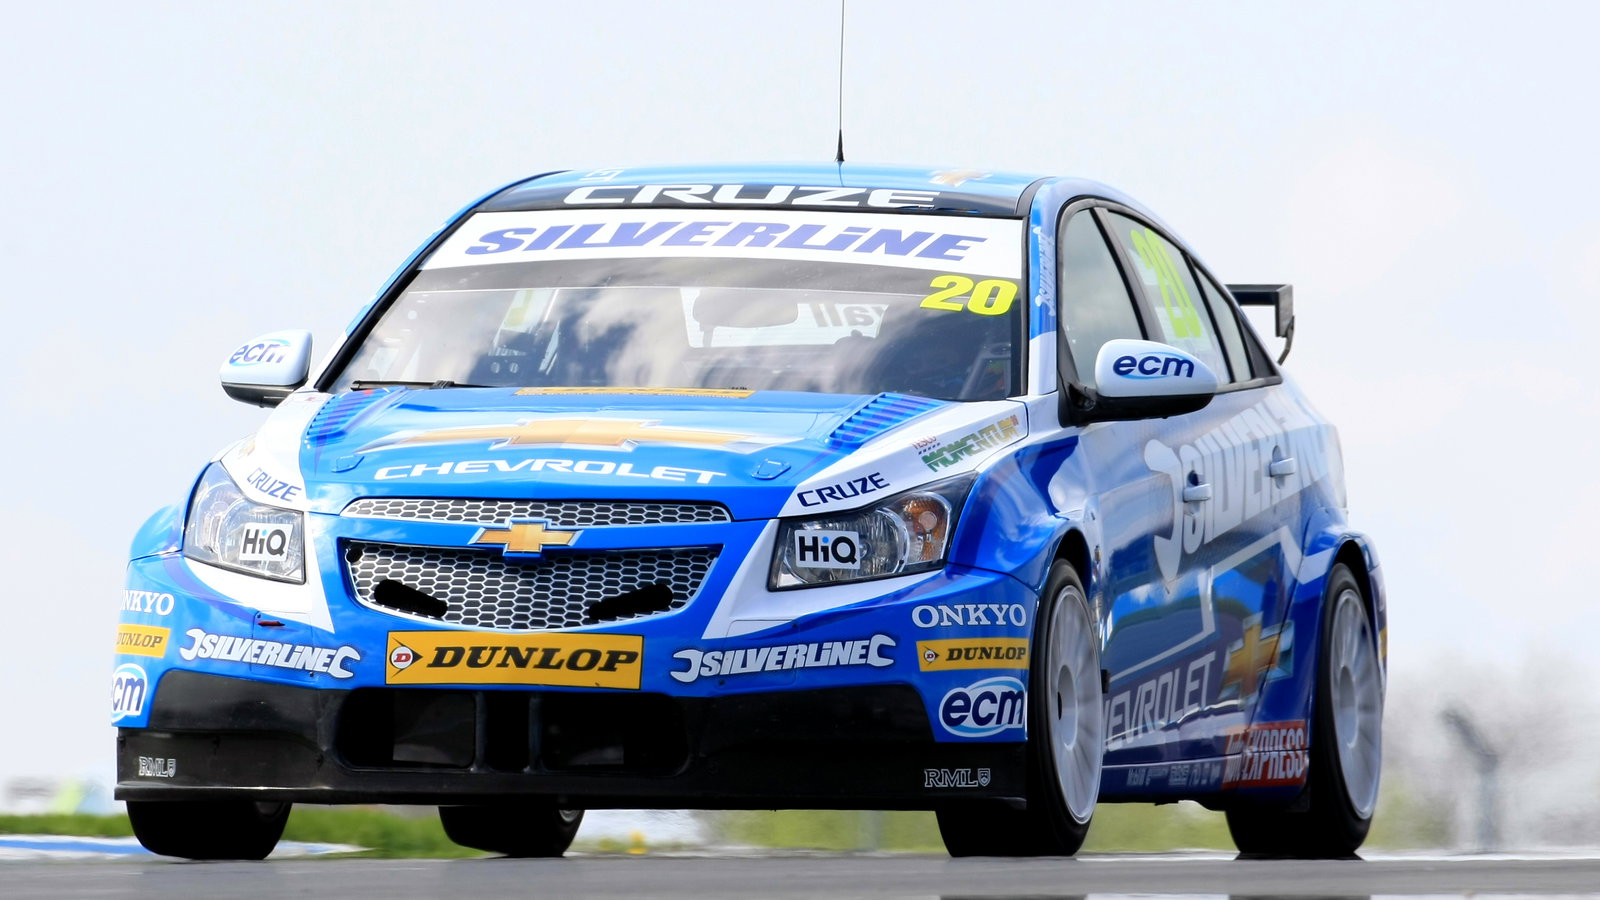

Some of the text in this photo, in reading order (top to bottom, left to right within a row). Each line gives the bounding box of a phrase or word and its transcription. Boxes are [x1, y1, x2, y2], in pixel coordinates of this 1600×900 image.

[563, 184, 940, 209] CRUZE
[920, 274, 1018, 316] 20
[1112, 355, 1195, 378] ecm
[246, 467, 302, 502] CRUZE
[374, 458, 727, 485] CHEVROLET
[797, 472, 891, 508] CRUZE
[242, 529, 287, 557] HiQ
[798, 536, 858, 565] HiQ
[120, 588, 175, 616] NKYO
[911, 603, 1028, 628] ONKYO
[426, 645, 640, 673] DUNLOP
[945, 646, 1027, 661] DUNLOP
[112, 676, 145, 712] cm
[941, 690, 1025, 727] ecm
[924, 768, 978, 787] RML
